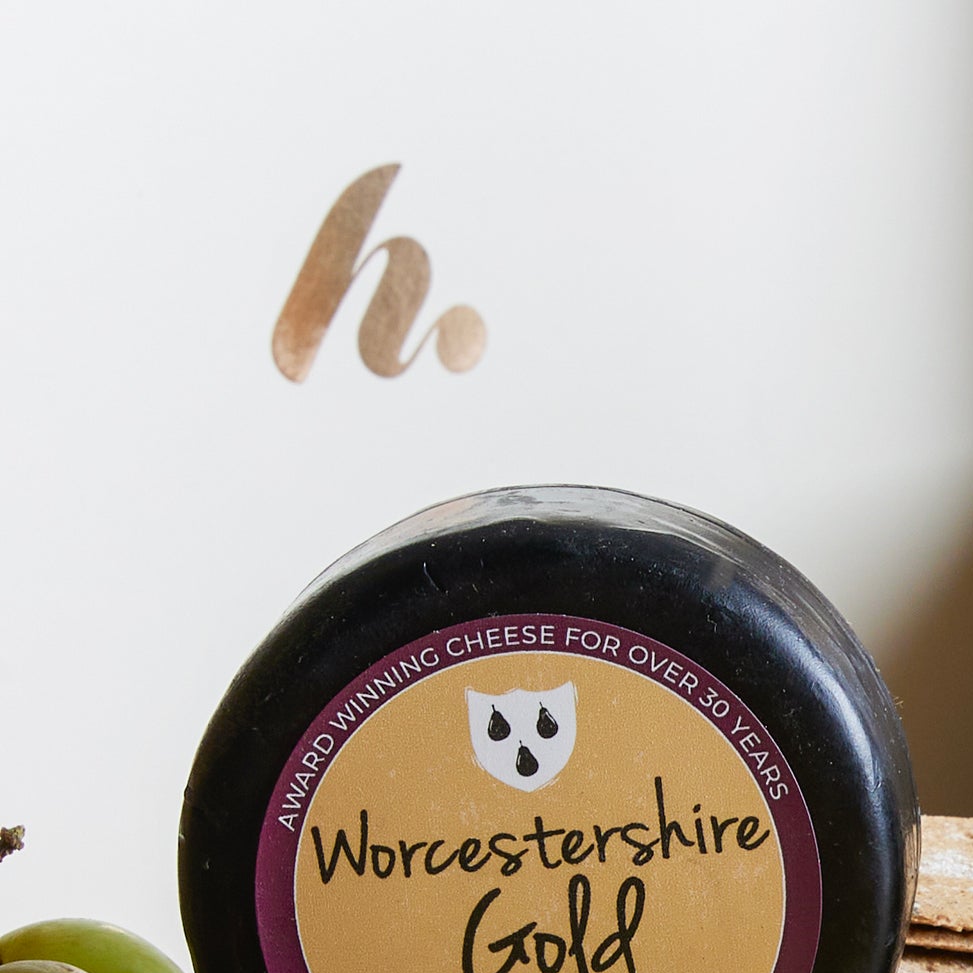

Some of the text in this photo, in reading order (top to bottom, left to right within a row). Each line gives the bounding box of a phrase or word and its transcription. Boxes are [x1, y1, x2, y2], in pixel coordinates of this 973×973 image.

[278, 625, 789, 832] AWARD WINNING CHEESE FOR OVER 30 YEARS
[311, 776, 770, 884] Worcestershire
